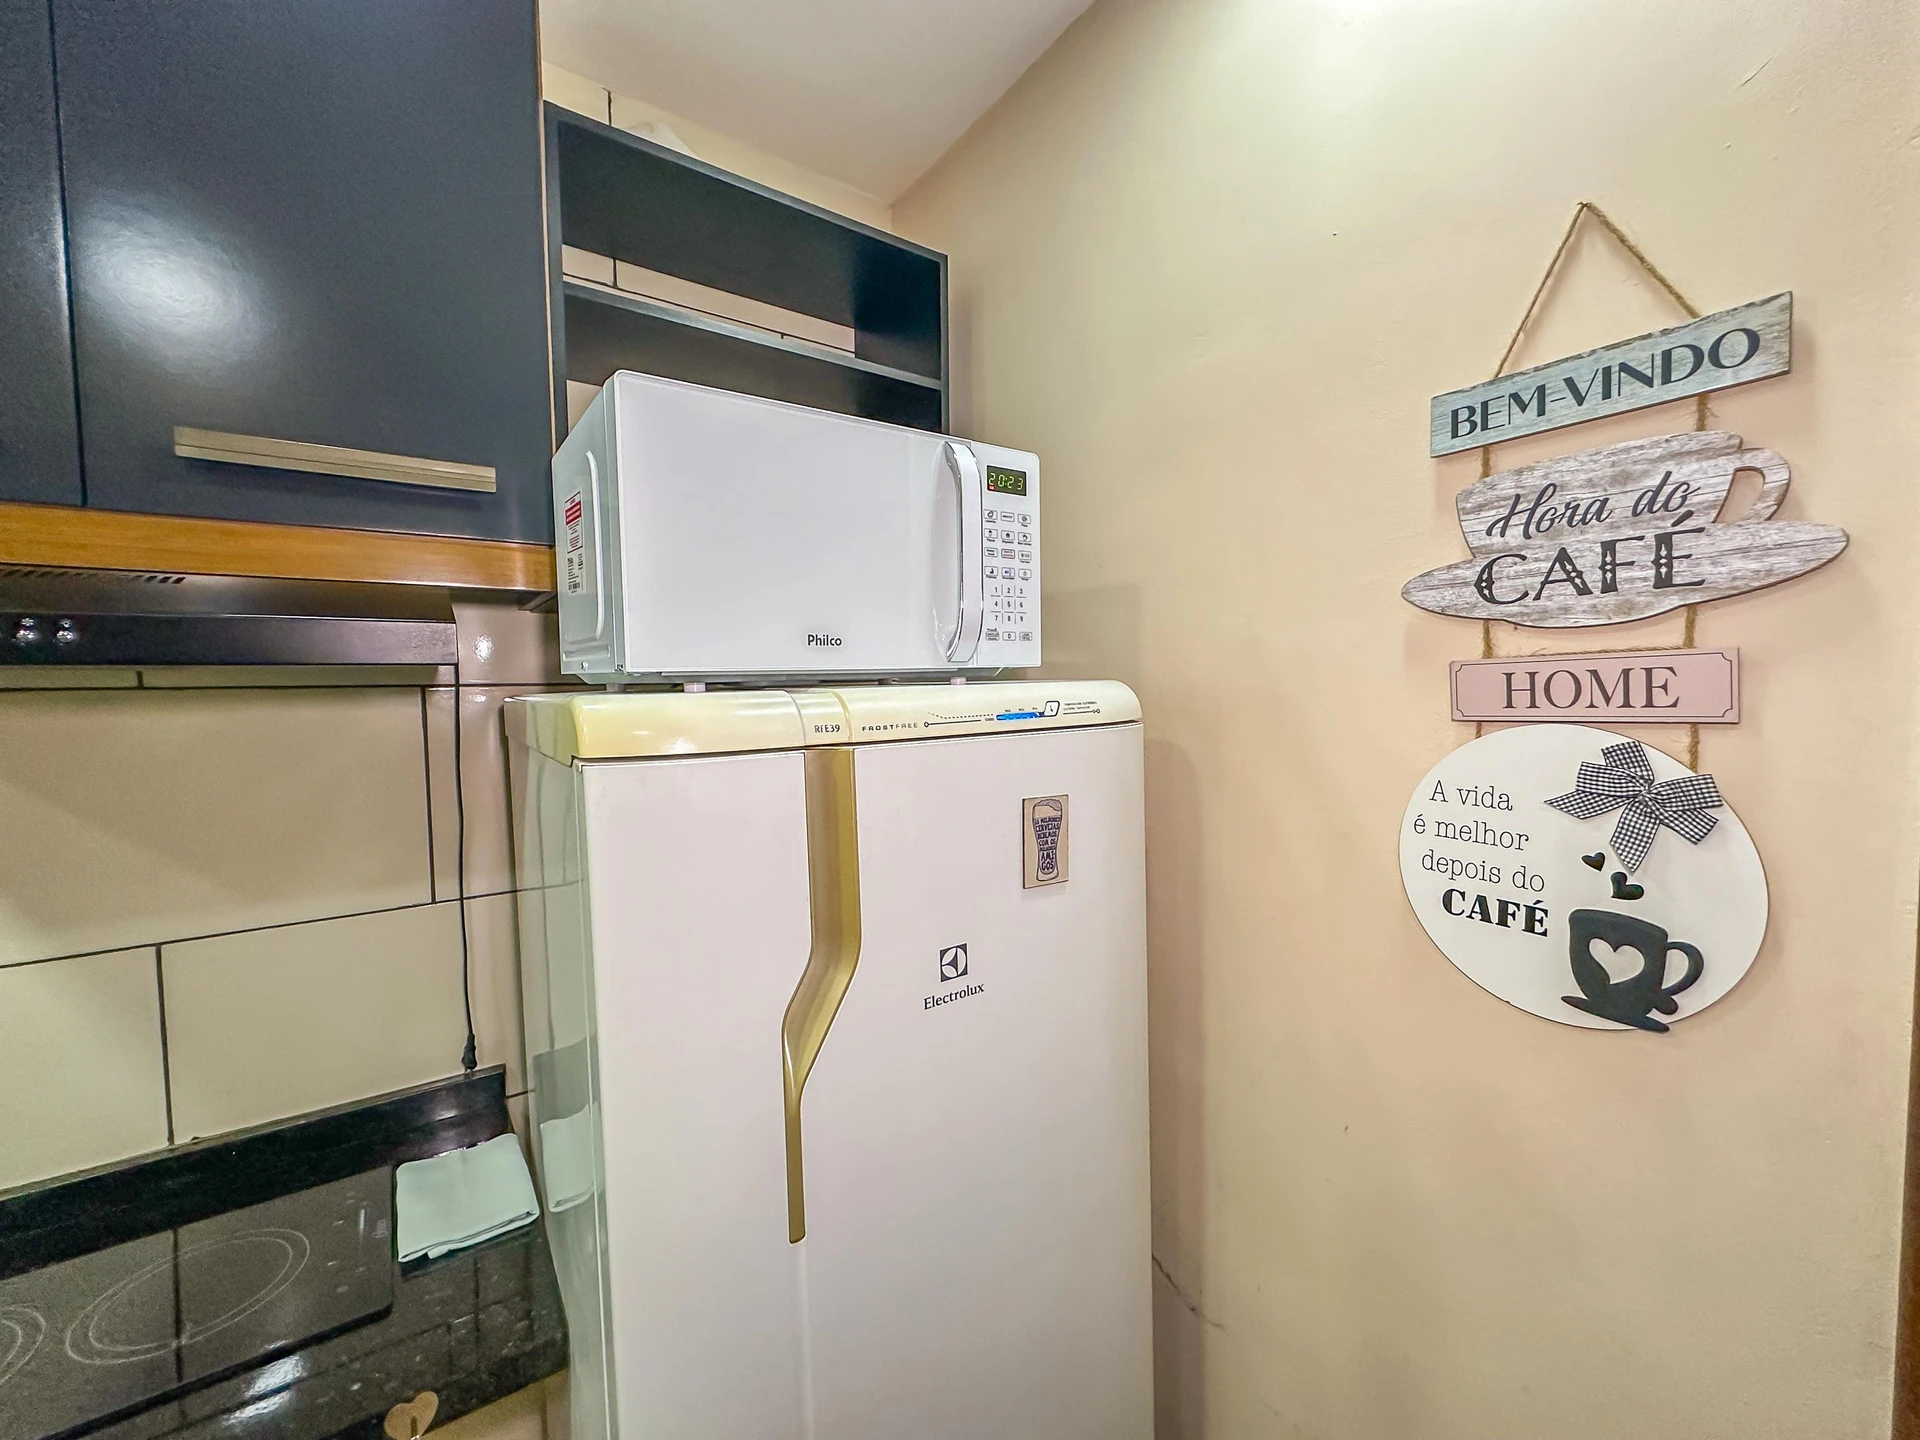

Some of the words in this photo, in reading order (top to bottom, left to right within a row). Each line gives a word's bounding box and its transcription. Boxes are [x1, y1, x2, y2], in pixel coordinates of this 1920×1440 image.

[1450, 327, 1761, 440] BEM-VINDO
[988, 472, 1024, 490] 20:23
[1485, 482, 1613, 540] Hora
[1631, 470, 1701, 518] do
[1473, 509, 1706, 606] CAFÉ
[807, 633, 843, 647] Philco
[1501, 665, 1681, 710] HOME
[1428, 779, 1449, 803] A
[1456, 785, 1514, 812] vida
[1413, 813, 1427, 835] é
[1434, 818, 1529, 851] melhor
[1421, 848, 1502, 885] depois
[1511, 864, 1546, 893] do
[1441, 887, 1550, 938] CAFÉ
[923, 983, 985, 1011] Electrolux
